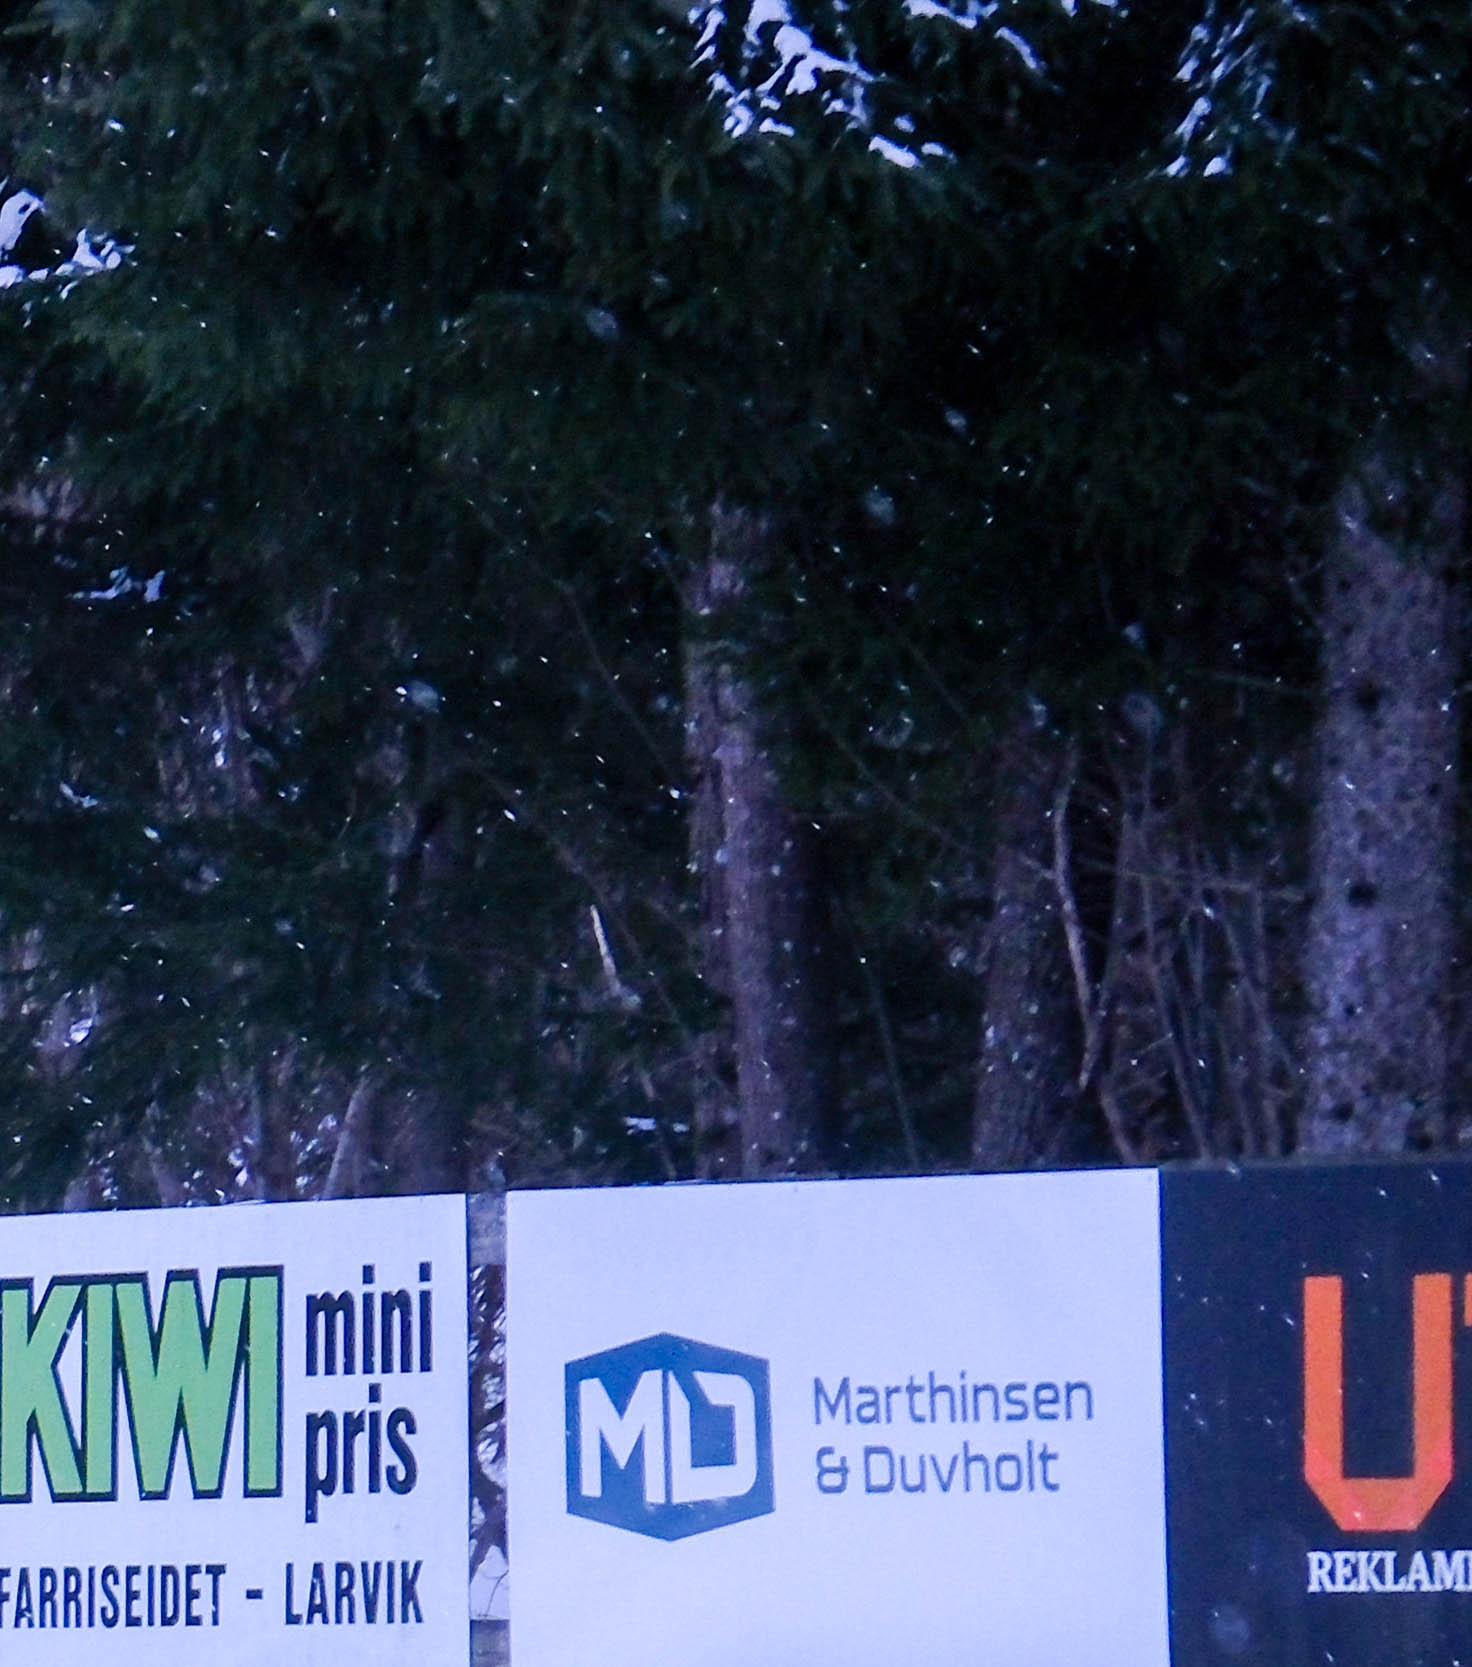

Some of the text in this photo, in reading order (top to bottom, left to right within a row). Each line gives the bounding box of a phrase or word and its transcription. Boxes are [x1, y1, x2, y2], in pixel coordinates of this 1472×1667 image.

[306, 1261, 432, 1377] mini
[814, 1370, 1094, 1426] Marthinsen
[305, 1382, 418, 1523] pris
[580, 1368, 757, 1504] MD
[816, 1439, 1061, 1495] & Duvholt
[285, 1559, 424, 1625] LARVIK
[1306, 1550, 1472, 1593] REKLAM
